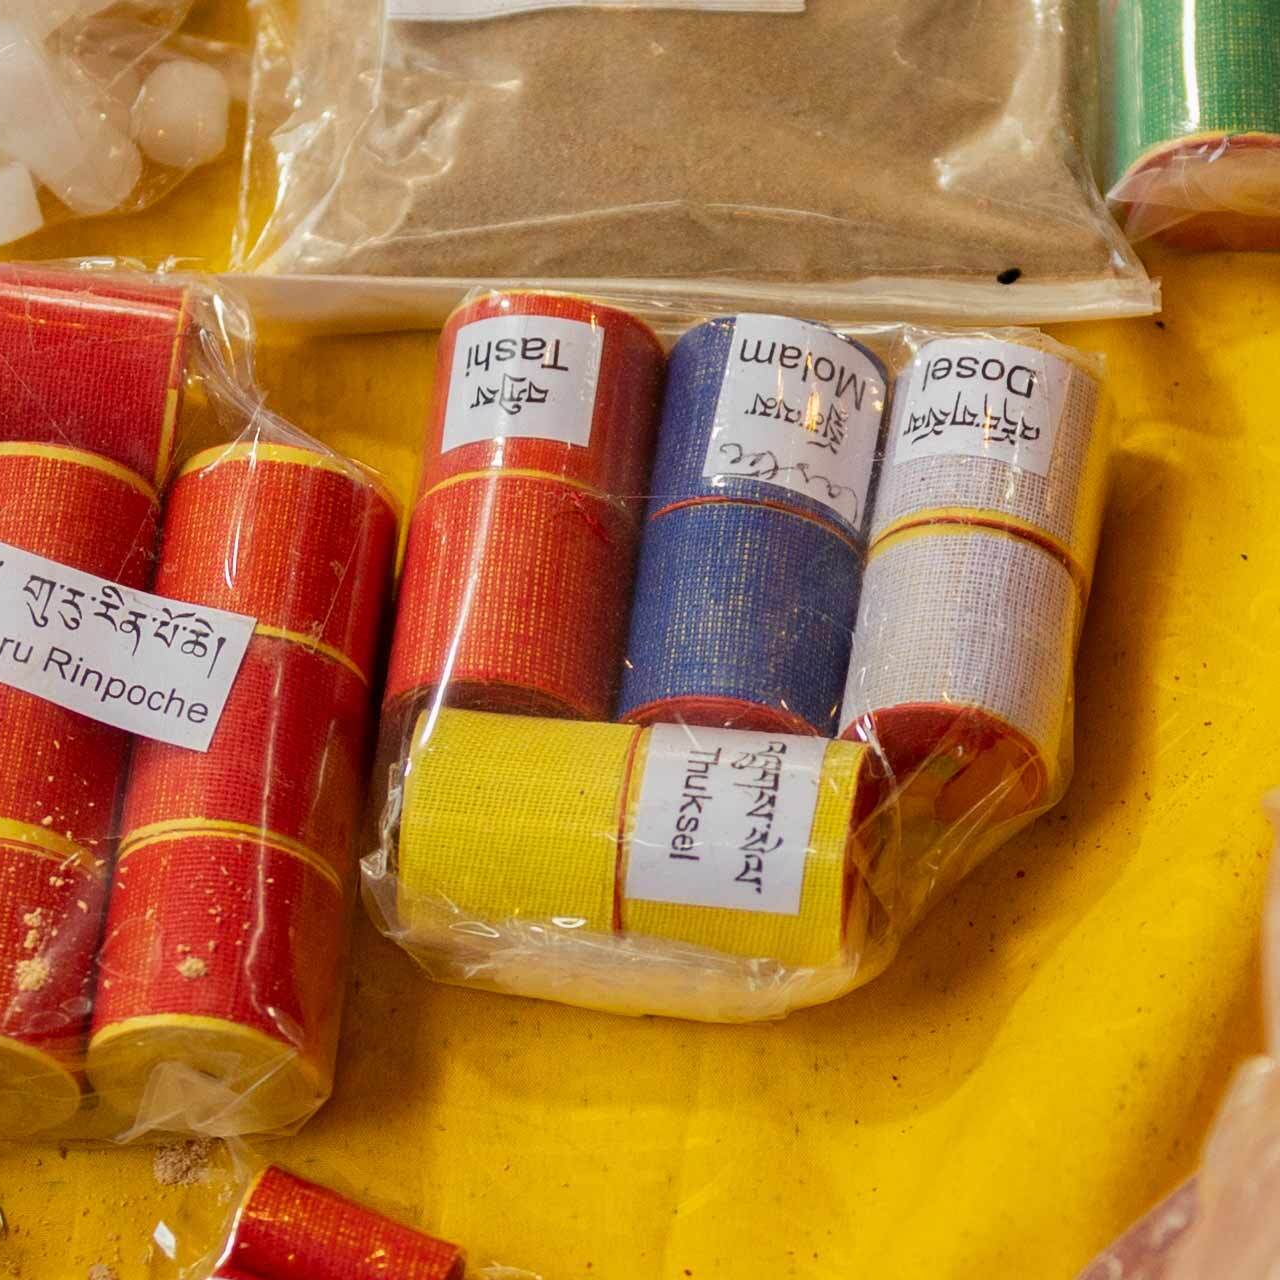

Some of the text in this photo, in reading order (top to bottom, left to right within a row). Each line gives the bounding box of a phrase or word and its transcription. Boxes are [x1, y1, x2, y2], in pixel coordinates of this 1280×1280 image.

[465, 335, 568, 377] Tashi
[740, 339, 867, 412] Molam
[922, 356, 1038, 401] Dosel
[42, 646, 208, 723] Rinpoche
[668, 747, 722, 864] Thuksel
